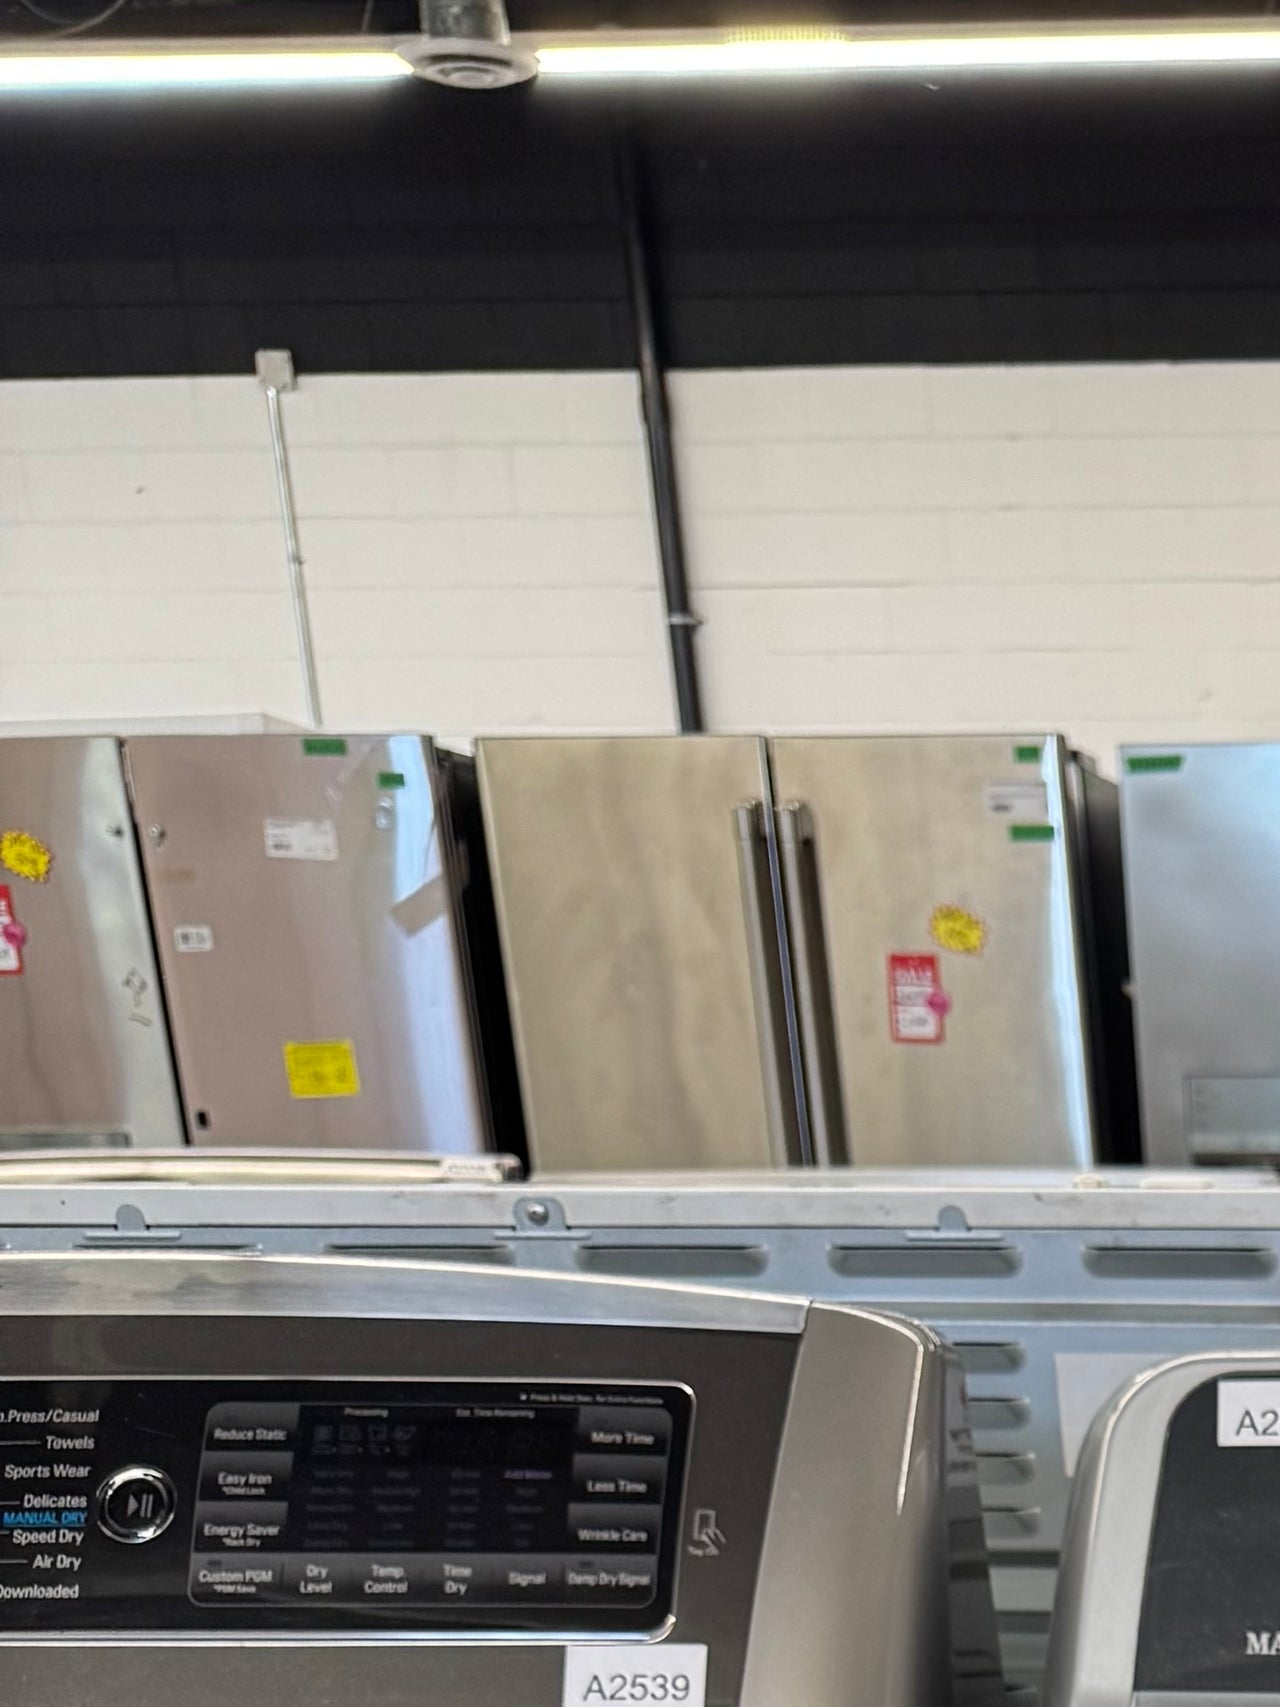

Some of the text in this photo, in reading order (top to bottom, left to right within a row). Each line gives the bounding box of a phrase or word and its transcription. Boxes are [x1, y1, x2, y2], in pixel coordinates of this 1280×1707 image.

[46, 1435, 95, 1450] Towels
[592, 1431, 654, 1446] More Time
[4, 1463, 91, 1480] Sports Wear
[218, 1471, 272, 1486] Easy Iron
[587, 1479, 647, 1493] Less Time
[23, 1493, 88, 1508] Delicates
[3, 1511, 88, 1525] MANUAL DRY
[12, 1530, 84, 1546] Speed Dry
[204, 1523, 281, 1538] Energy Saver
[578, 1528, 648, 1542] Wrinkle Care
[32, 1554, 82, 1571] Air Dry
[306, 1564, 328, 1579] Dry
[443, 1564, 472, 1578] Time
[508, 1571, 546, 1587] Signal
[567, 1572, 650, 1587] Damp Dry Signal
[300, 1581, 332, 1594] Level
[364, 1581, 408, 1594] Control
[445, 1581, 467, 1596] Dry
[582, 1673, 692, 1703] A2539
